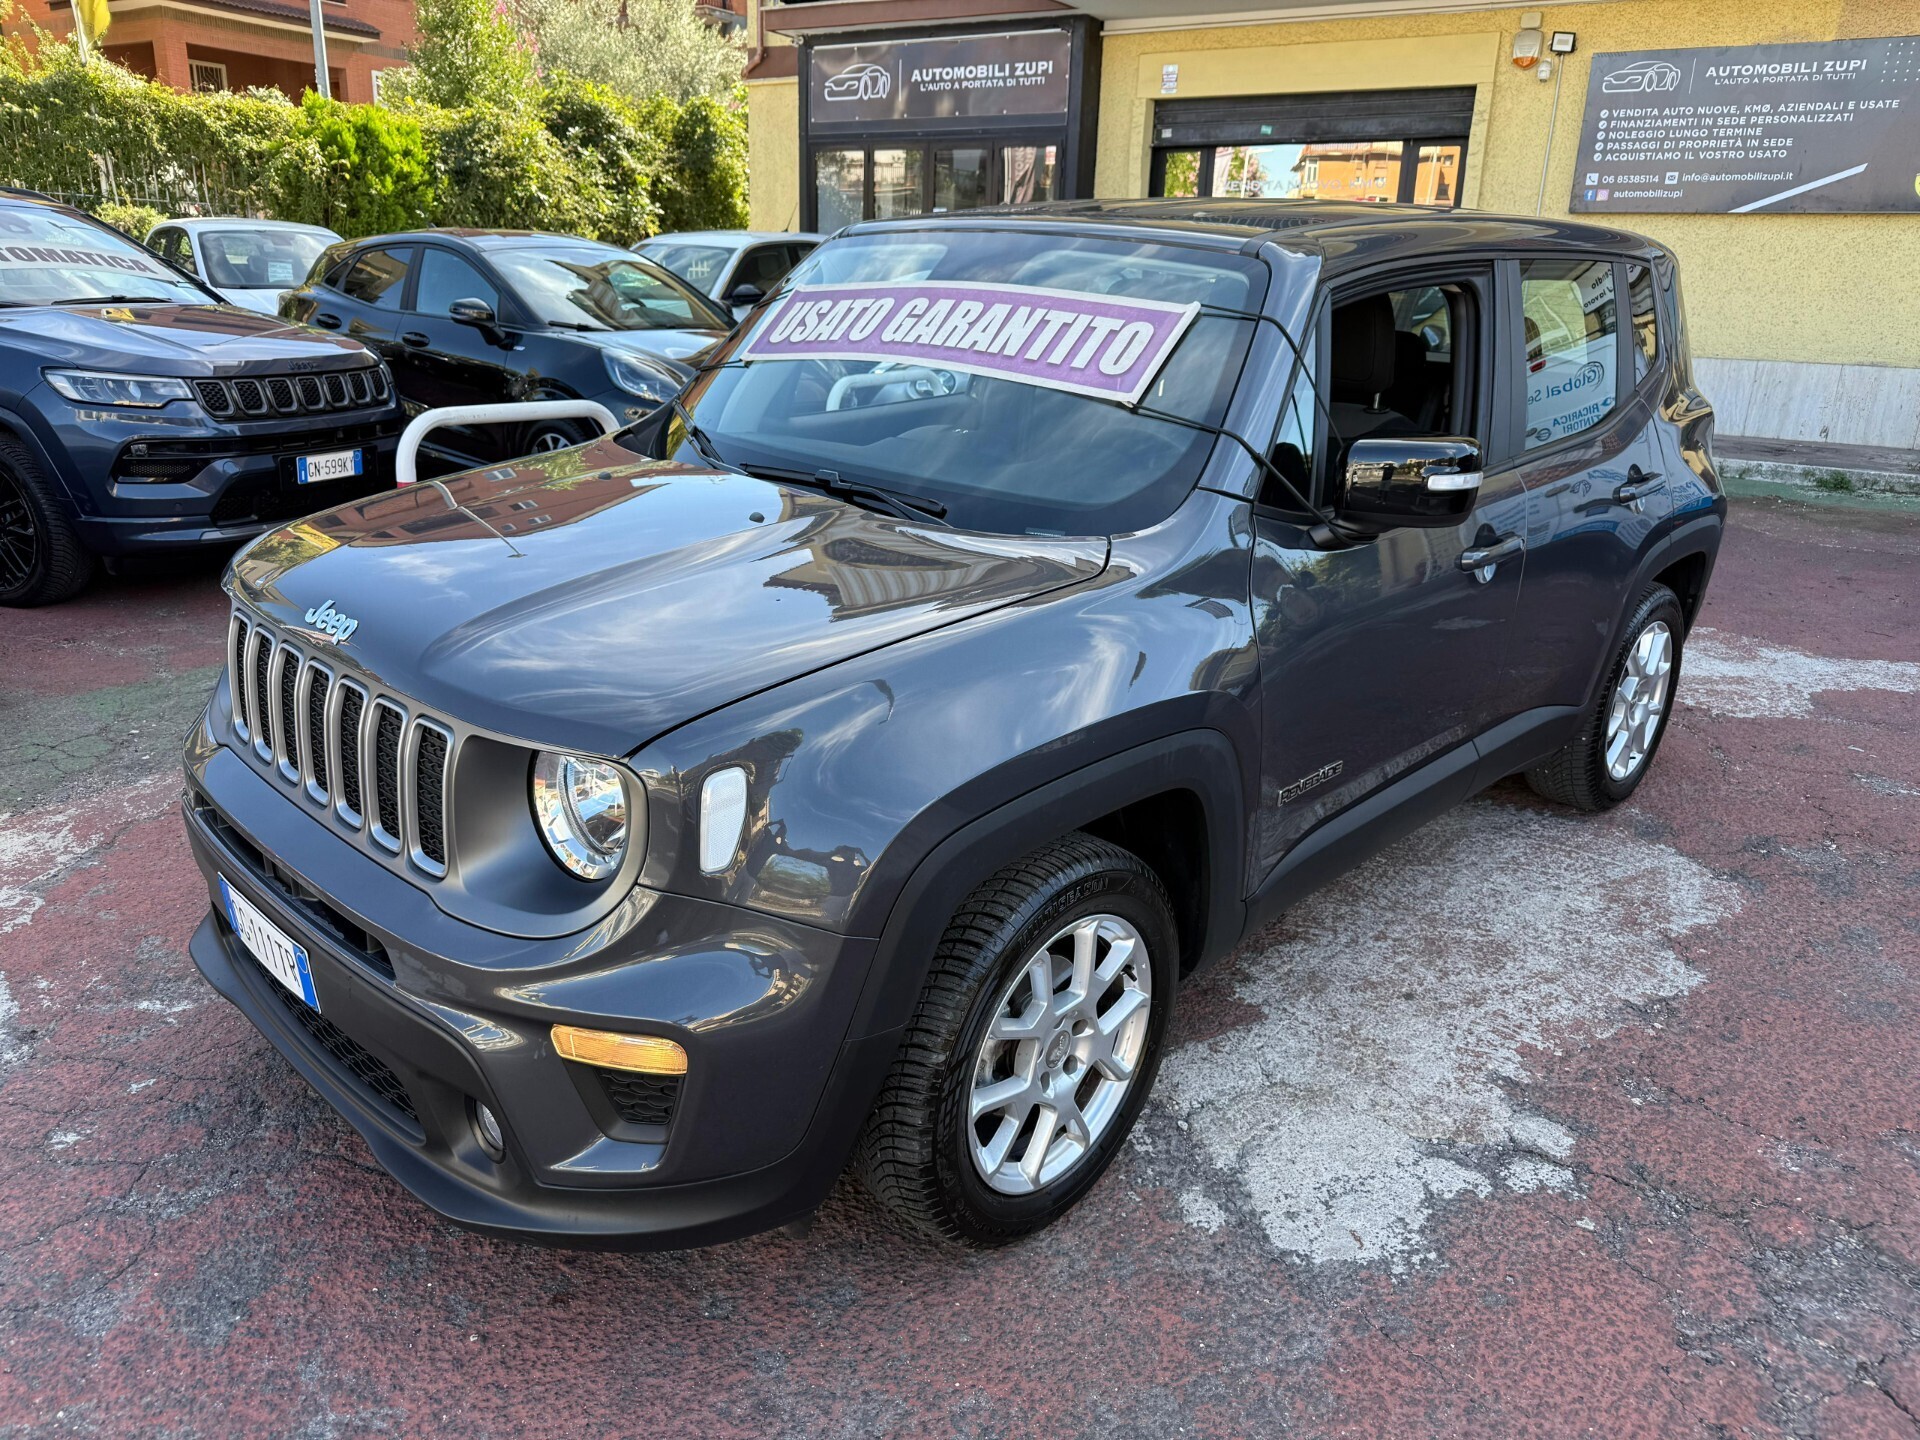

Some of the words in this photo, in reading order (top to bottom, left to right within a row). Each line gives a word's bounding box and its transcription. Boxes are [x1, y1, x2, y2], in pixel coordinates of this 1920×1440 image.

[911, 63, 1010, 82] AUTOMOBILI
[1014, 60, 1054, 76] ZUPI
[1705, 61, 1819, 78] AUTOMOBILI
[1822, 59, 1868, 73] ZUPI
[920, 81, 952, 91] L'AUTO
[953, 81, 960, 90] A
[961, 79, 1005, 89] PORTATA
[1006, 78, 1016, 87] DI
[1019, 76, 1046, 86] TUTTI
[1714, 77, 1750, 85] L'AUTO
[1752, 76, 1760, 84] A
[1762, 74, 1809, 83] PORTATA
[1812, 73, 1823, 81] DI
[1827, 72, 1857, 81] TUTTI
[1612, 107, 1659, 118] VENDITA
[1662, 106, 1694, 116] AUTO
[1697, 105, 1741, 116] NUOVE,
[1778, 101, 1844, 112] AZIENDALI
[1848, 101, 1856, 110] E
[1860, 99, 1900, 109] USATE
[1610, 117, 1698, 129] FINANZIAMENTI
[1701, 117, 1714, 126] IN
[1717, 116, 1747, 125] SEDE
[1750, 112, 1854, 125] PERSONALIZZATI
[1608, 129, 1666, 140] NOLEGGIO
[1669, 128, 1709, 138] LUNGO
[1712, 127, 1763, 137] TERMINE
[1606, 140, 1661, 151] PASSAGGI
[1663, 140, 1675, 149] DI
[1678, 137, 1743, 149] PROPRIETÀ
[1747, 138, 1759, 148] IN
[1763, 137, 1794, 147] SEDE
[1605, 151, 1682, 162] ACQUISTIAMO
[1685, 151, 1695, 160] IL
[1699, 150, 1745, 160] VOSTRO
[1749, 149, 1788, 159] USATO
[1602, 175, 1615, 184] 06
[1617, 174, 1660, 184] 85385114
[1682, 172, 1794, 183] info@automobilizupi.it
[1613, 189, 1684, 199] automobilizupi
[768, 297, 896, 345] USATO
[880, 297, 1156, 377] GARANTITO
[304, 599, 359, 646] Jeep
[1277, 760, 1344, 807] RENEGADE
